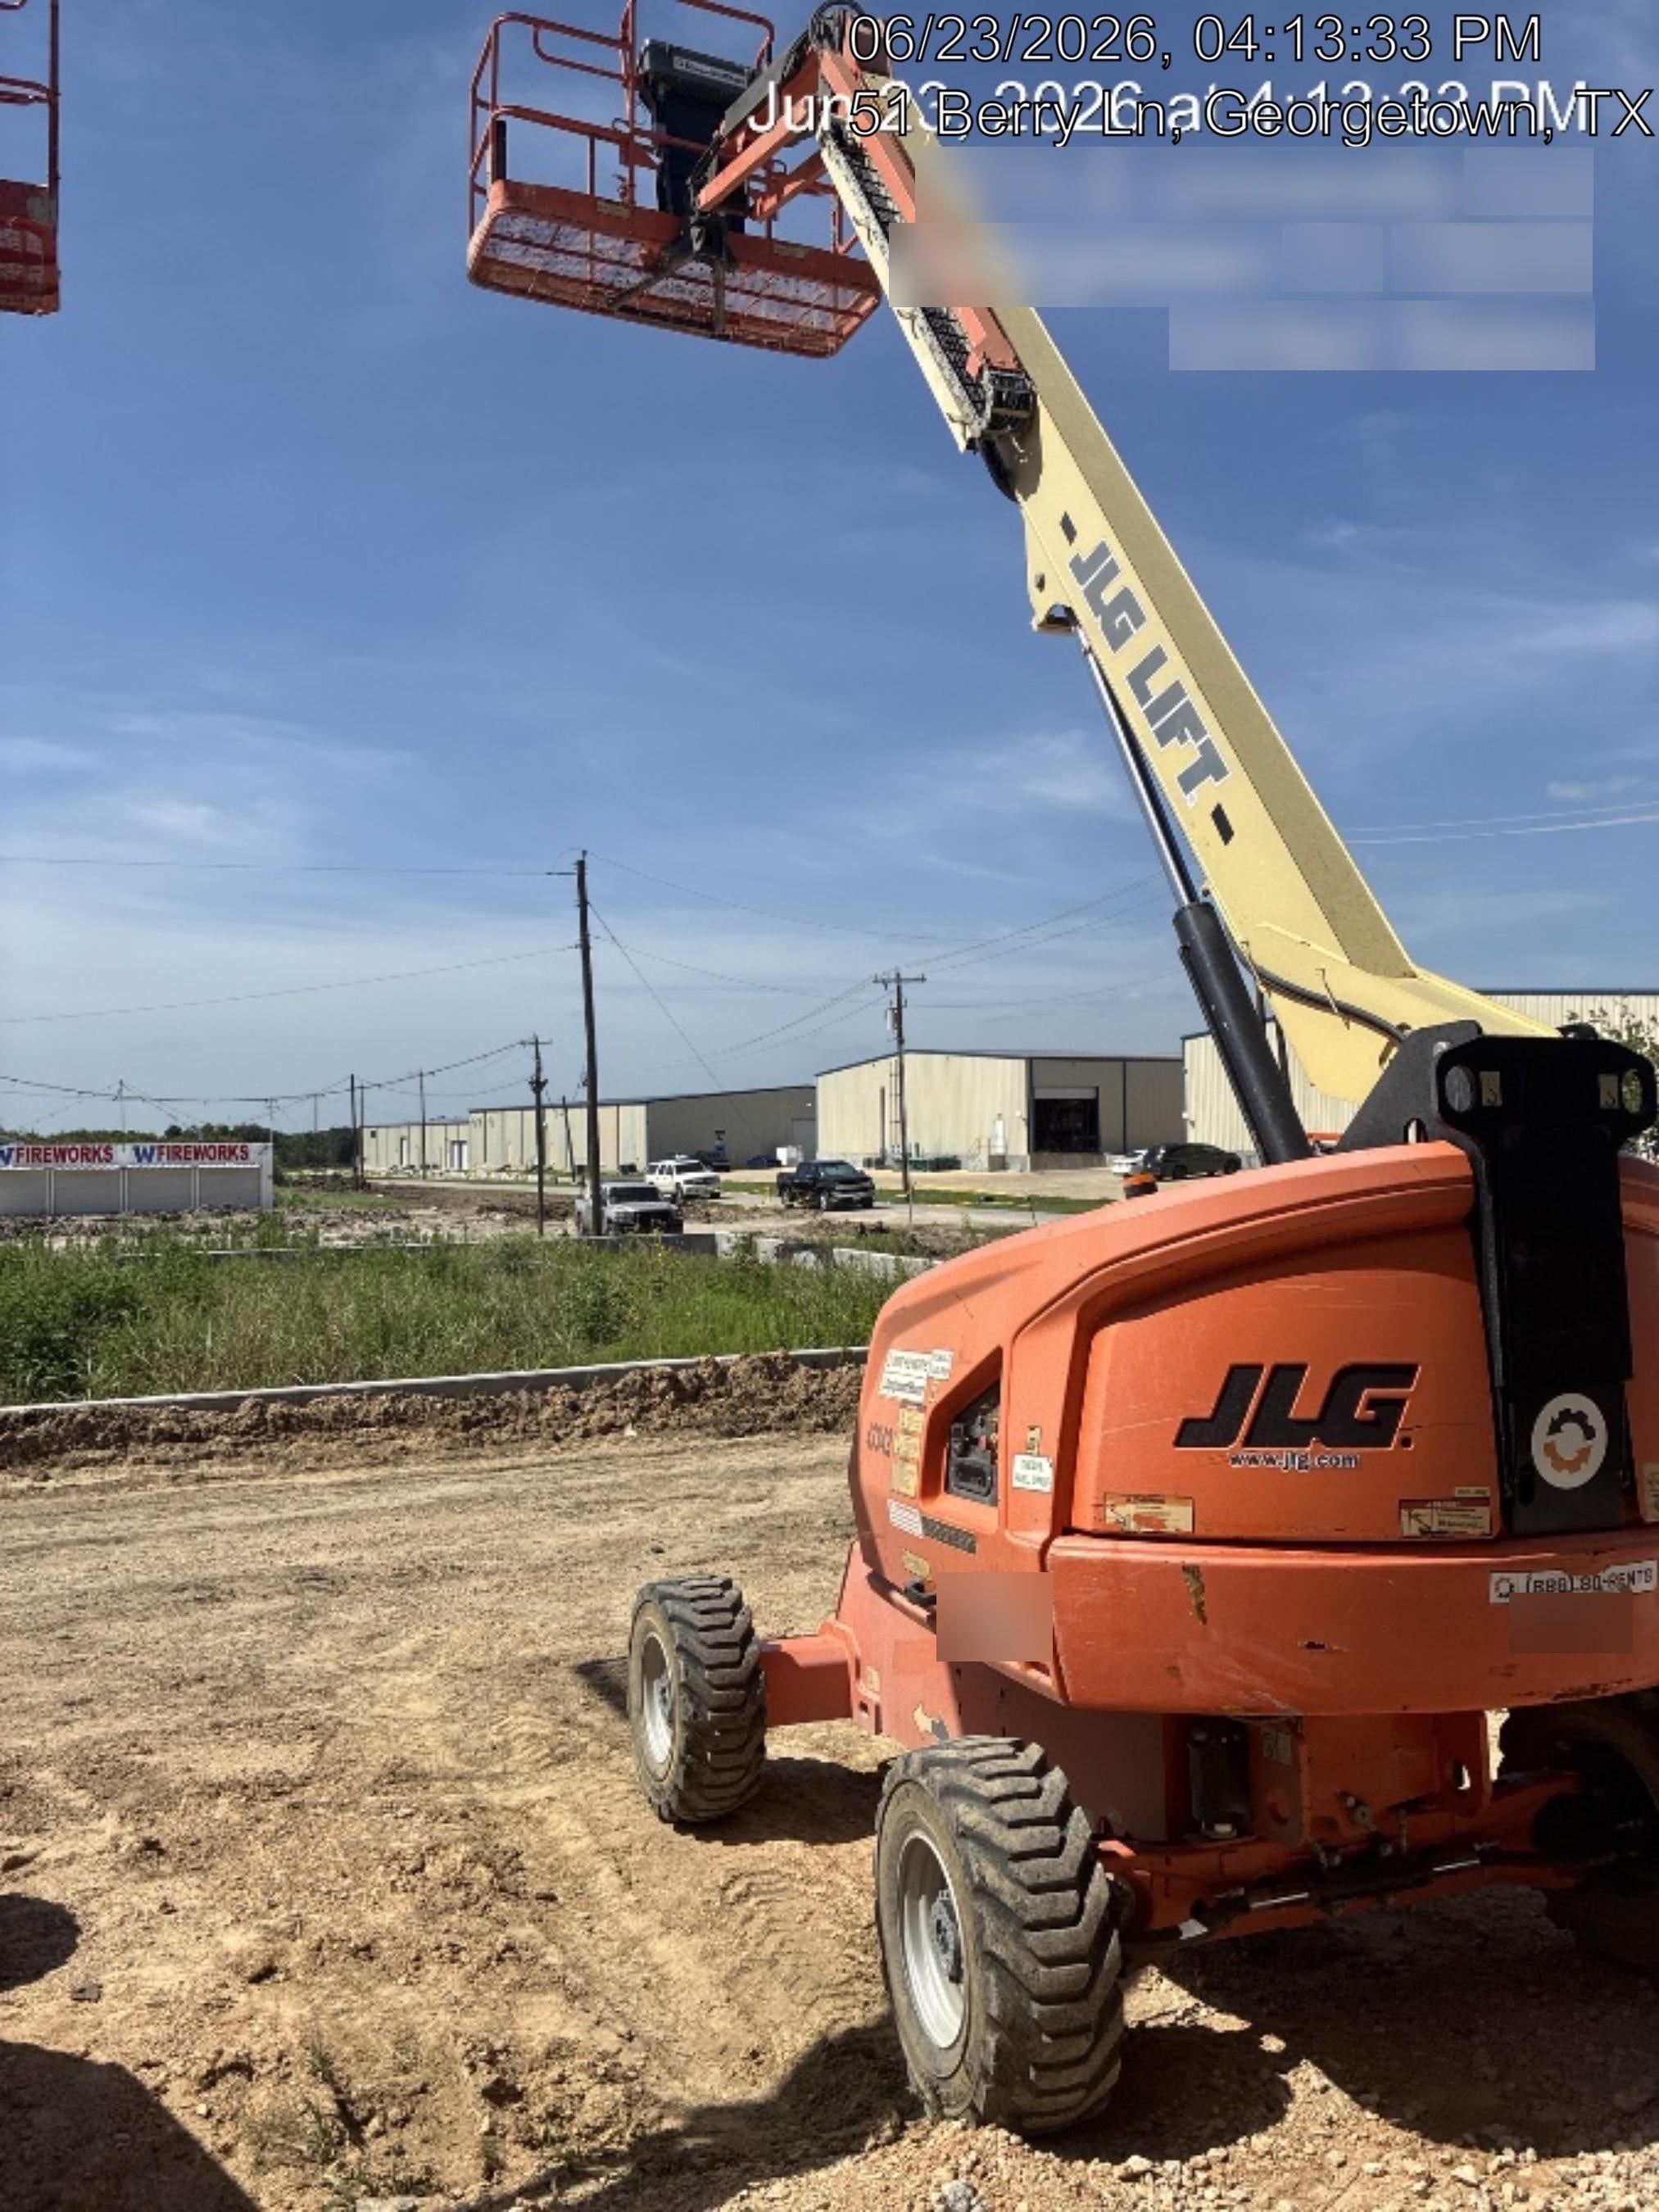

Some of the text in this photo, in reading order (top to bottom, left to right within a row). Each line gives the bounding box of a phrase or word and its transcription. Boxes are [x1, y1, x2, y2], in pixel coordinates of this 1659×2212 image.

[1068, 539, 1231, 805] JLG LIFT
[1228, 1451, 1359, 1472] www.jlg.com
